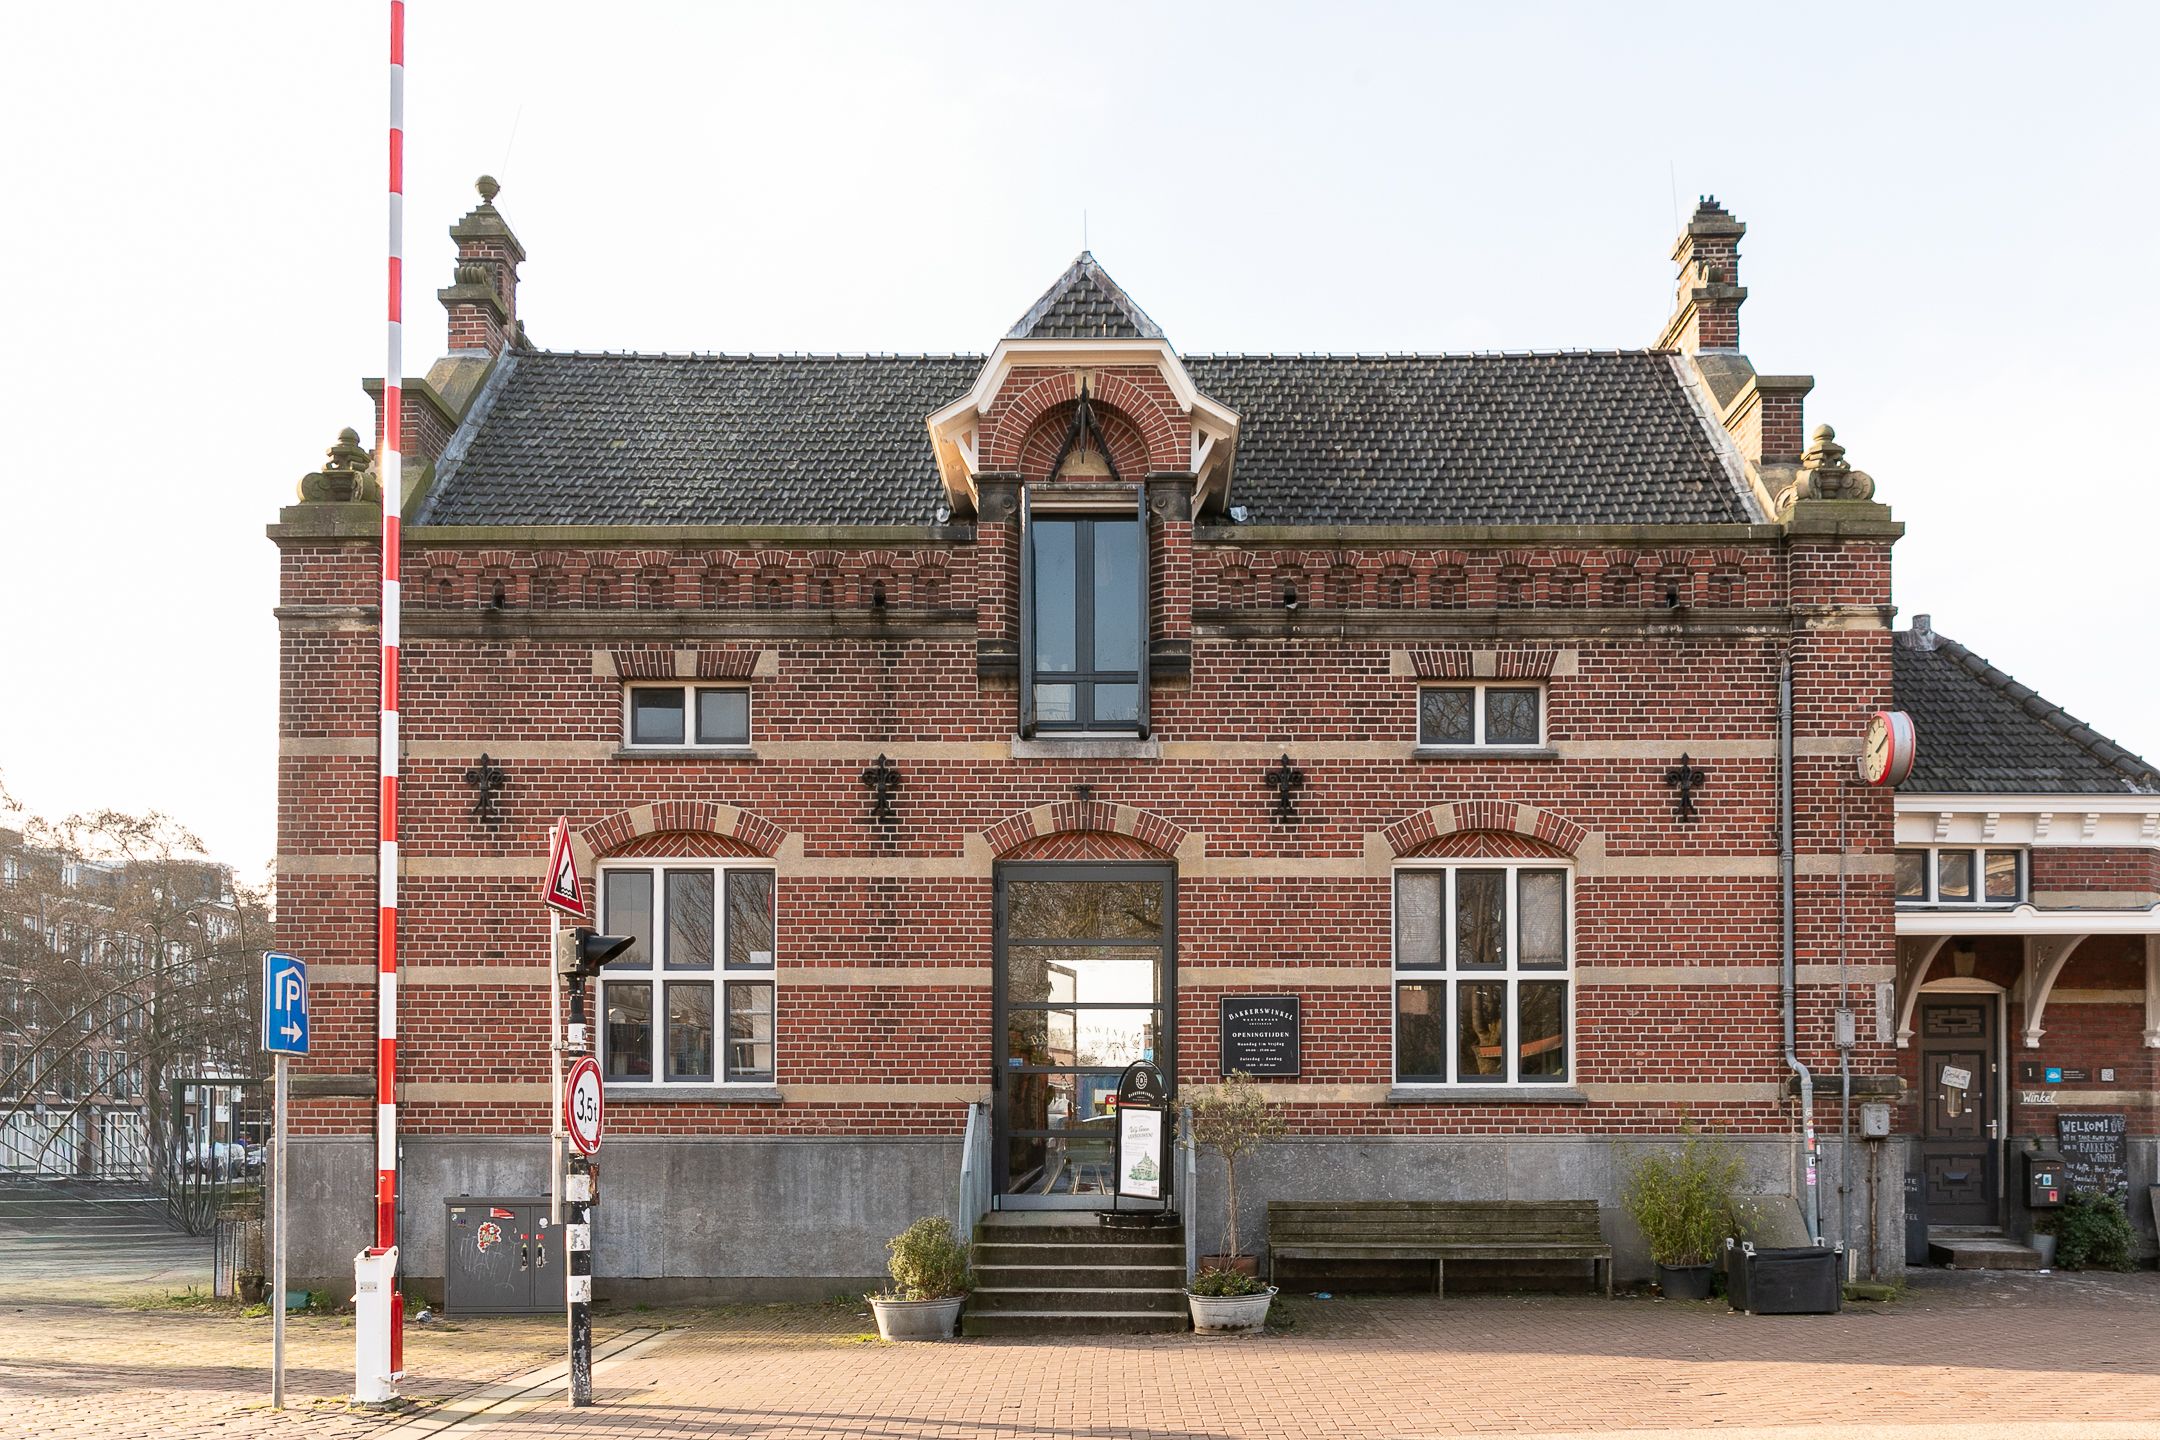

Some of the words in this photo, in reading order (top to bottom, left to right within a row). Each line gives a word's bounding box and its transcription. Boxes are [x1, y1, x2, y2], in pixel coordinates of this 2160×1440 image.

[286, 979, 300, 1011] P
[1228, 1007, 1293, 1021] BAKKERSWINKEL
[2027, 1067, 2032, 1077] 1
[2022, 1090, 2057, 1103] Winkel
[2061, 1119, 2109, 1133] WELKOM!
